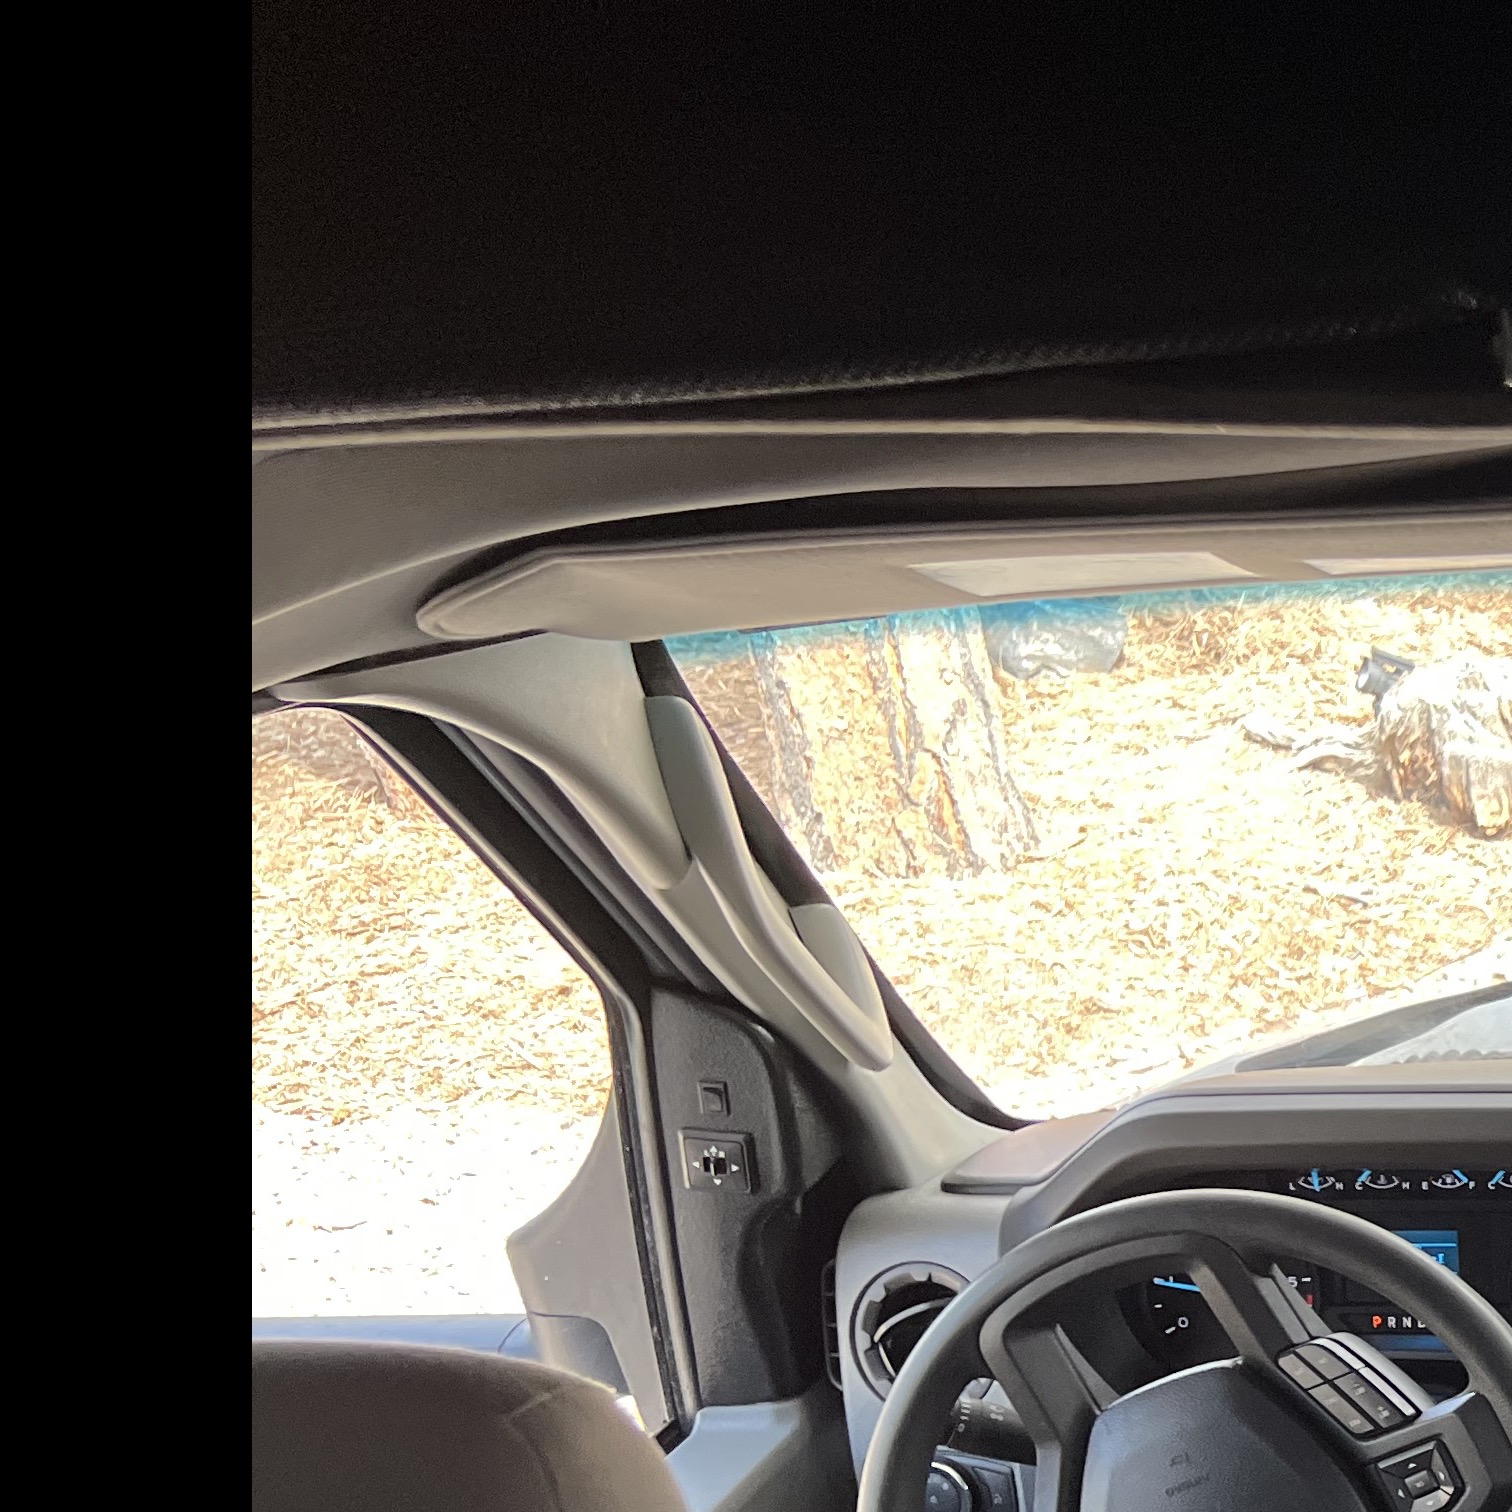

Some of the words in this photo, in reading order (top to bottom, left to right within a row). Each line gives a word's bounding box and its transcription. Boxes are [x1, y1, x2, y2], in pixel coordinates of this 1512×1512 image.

[1288, 1182, 1296, 1190] L
[1354, 1181, 1364, 1190] C
[1286, 1276, 1298, 1288] 5
[1177, 1316, 1189, 1328] 0
[1372, 1315, 1383, 1329] P
[1387, 1316, 1397, 1329] R
[1402, 1316, 1412, 1328] N
